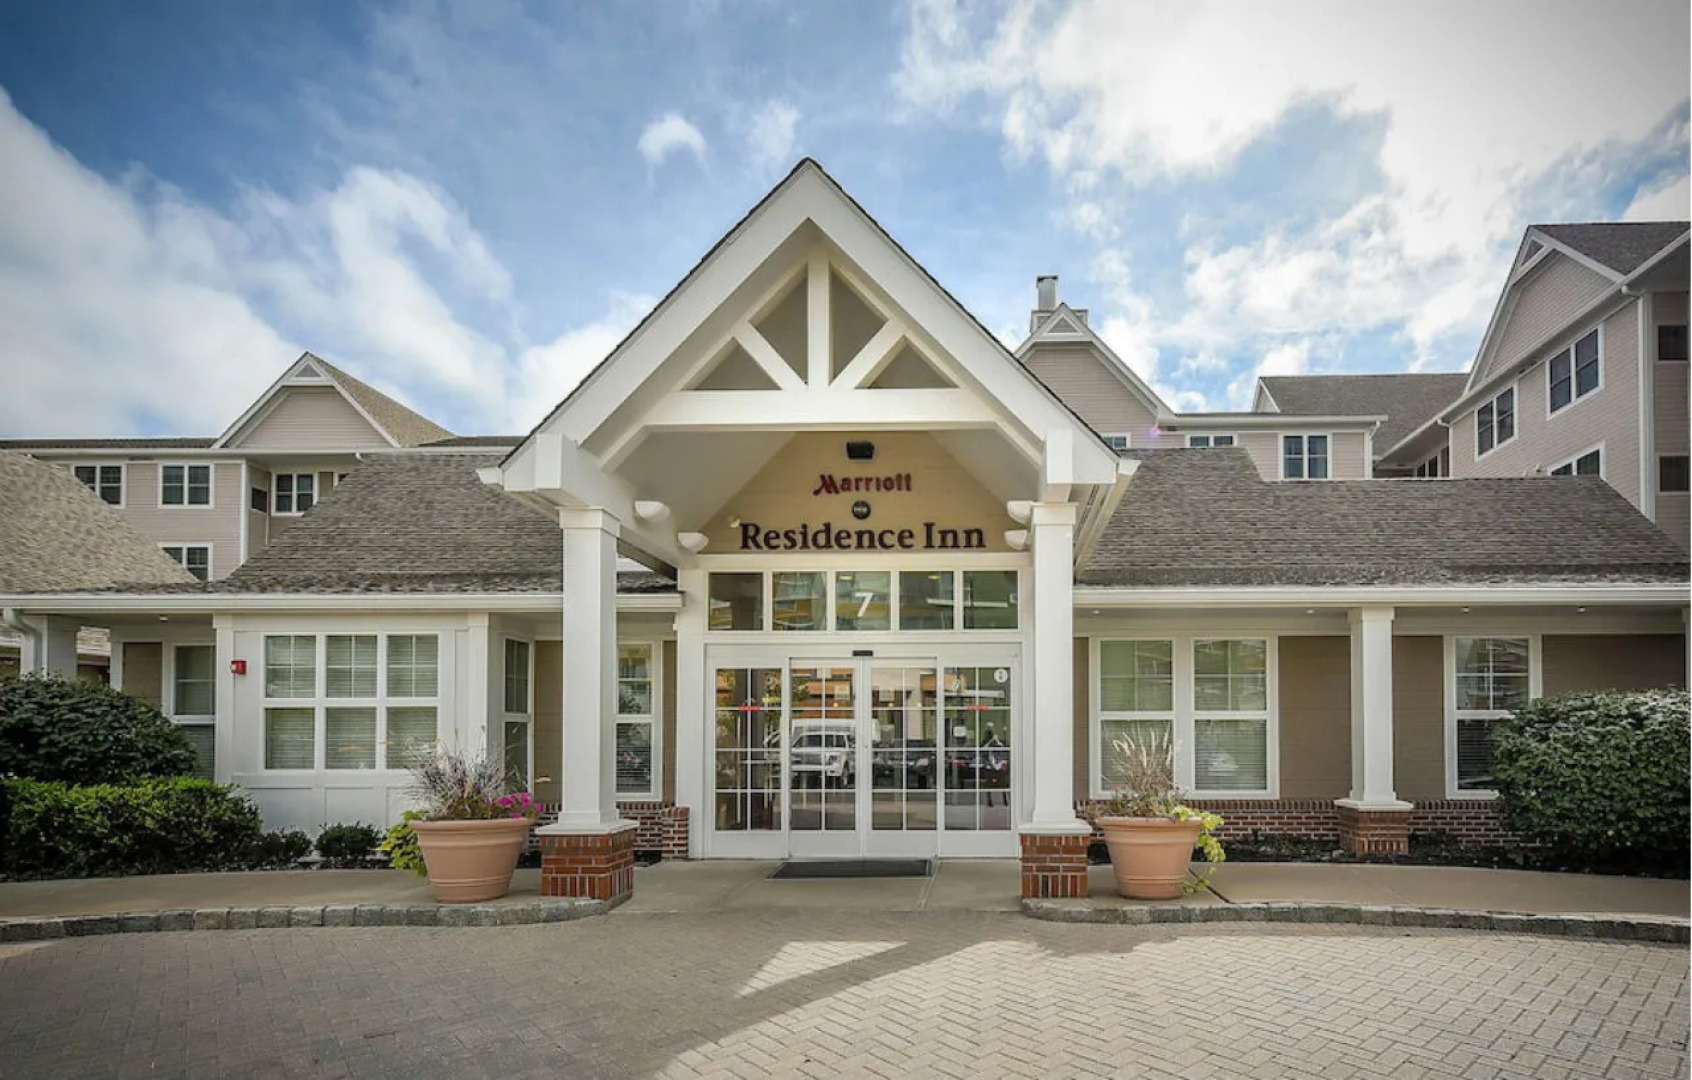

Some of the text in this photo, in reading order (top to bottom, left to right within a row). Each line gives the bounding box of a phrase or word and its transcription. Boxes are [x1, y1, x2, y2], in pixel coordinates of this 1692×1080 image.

[813, 473, 912, 496] Marriott
[739, 522, 986, 550] Residence Inn
[855, 591, 874, 617] 7
